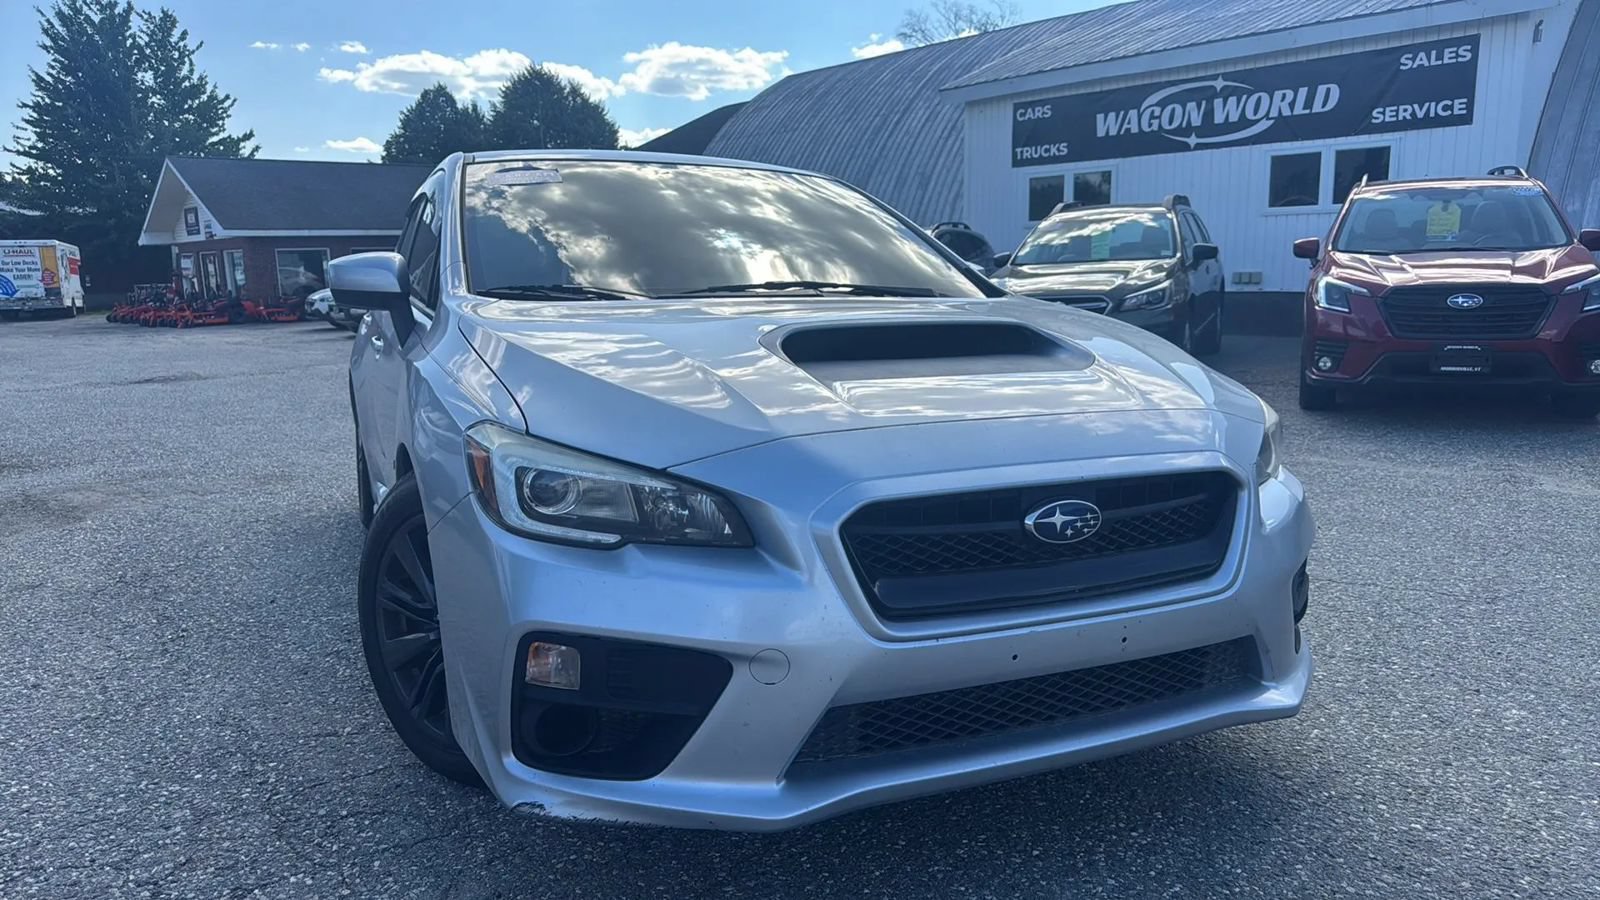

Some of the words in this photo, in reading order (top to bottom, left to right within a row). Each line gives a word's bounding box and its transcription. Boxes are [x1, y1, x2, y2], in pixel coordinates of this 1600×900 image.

[1400, 45, 1472, 71] SALES
[1016, 104, 1052, 121] CARS
[1096, 100, 1205, 137] WAGON
[1214, 83, 1340, 123] WORLD
[1371, 98, 1468, 124] SERVICE
[1015, 143, 1068, 160] TRUCKS
